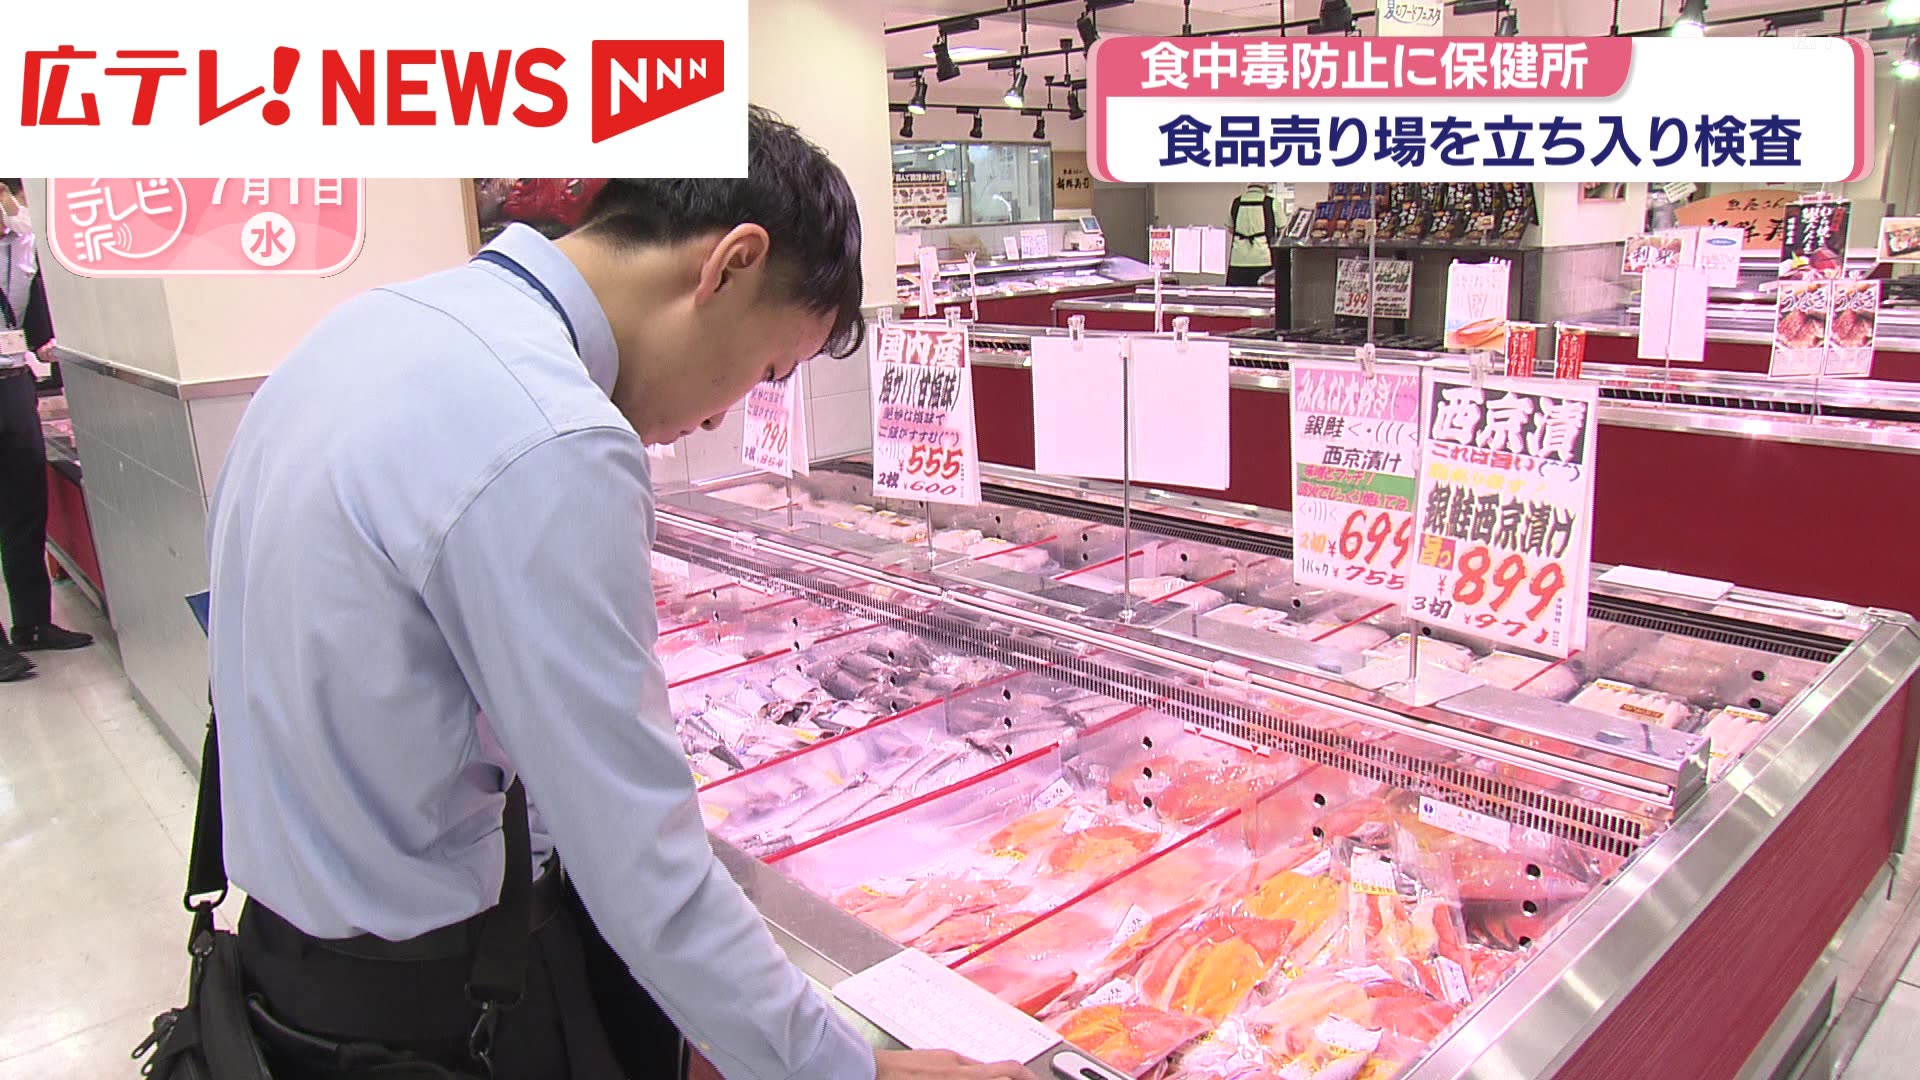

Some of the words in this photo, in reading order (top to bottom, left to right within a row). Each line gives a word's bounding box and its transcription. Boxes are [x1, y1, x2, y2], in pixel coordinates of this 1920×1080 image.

[880, 328, 963, 368] 国内産
[1304, 414, 1345, 438] 銀鮭
[1432, 387, 1586, 463] 西京漬
[1322, 445, 1402, 473] 西京漬け
[877, 472, 900, 489] 2枚
[1424, 480, 1577, 559] 銀鮭西京漬け
[1411, 596, 1453, 619] 3切
